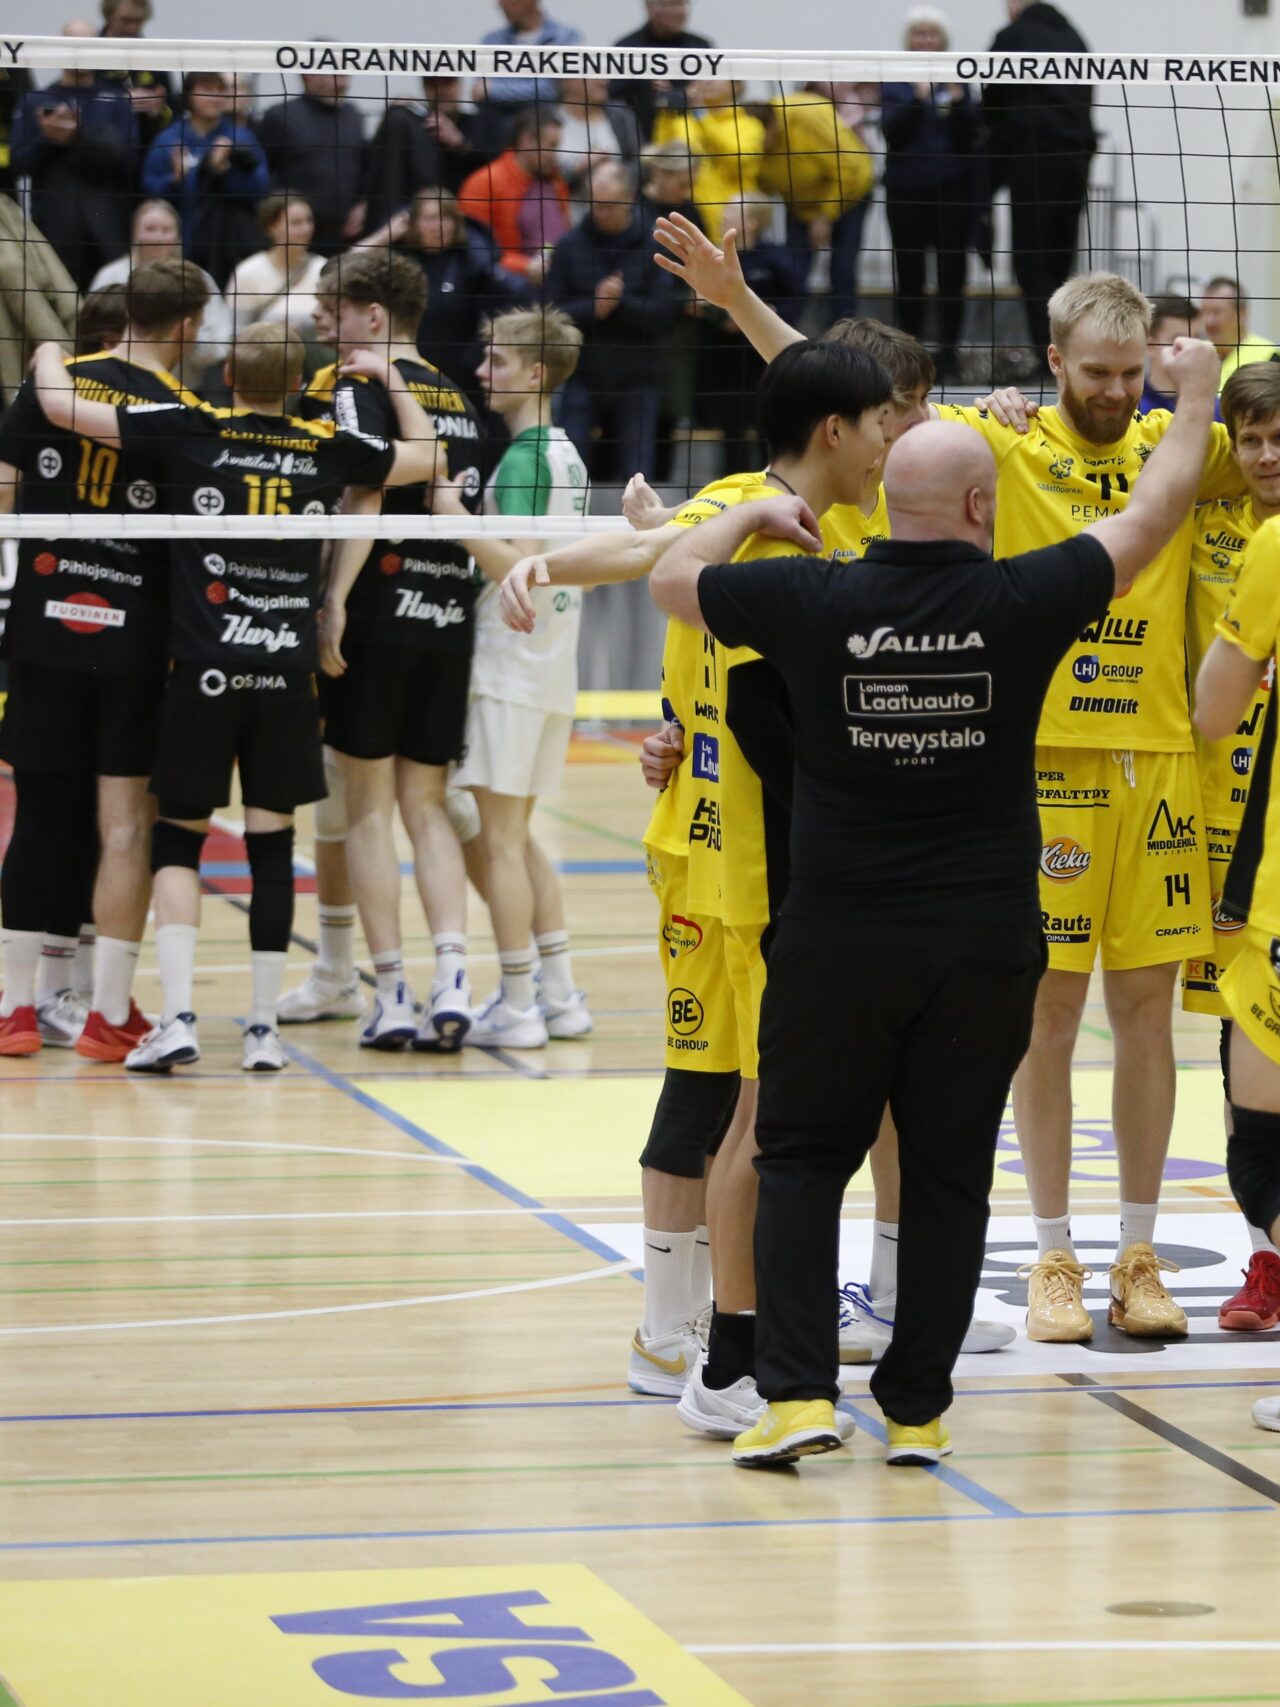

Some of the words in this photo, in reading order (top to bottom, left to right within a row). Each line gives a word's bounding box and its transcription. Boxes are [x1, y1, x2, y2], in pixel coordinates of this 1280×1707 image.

[276, 45, 477, 74] OJARANNAN
[494, 49, 669, 77] RAKENNUS
[680, 54, 724, 78] OY
[956, 57, 1149, 81] OJARANNAN
[394, 587, 465, 629] Hurja
[220, 613, 300, 653] Hurja
[854, 626, 985, 659] SALLILA
[1074, 662, 1097, 679] LHJ
[1102, 664, 1144, 679] GROUP
[859, 682, 909, 693] Loimaan
[859, 693, 975, 711] Laatuauto
[848, 726, 985, 754] Terveystalo
[895, 757, 936, 766] SPORT
[1147, 837, 1198, 850] MIDDLEHILL
[1164, 872, 1191, 907] 14
[1155, 926, 1192, 937] CRAFT
[671, 998, 699, 1025] BE
[1250, 1002, 1263, 1022] BE
[675, 1038, 709, 1051] GROUP
